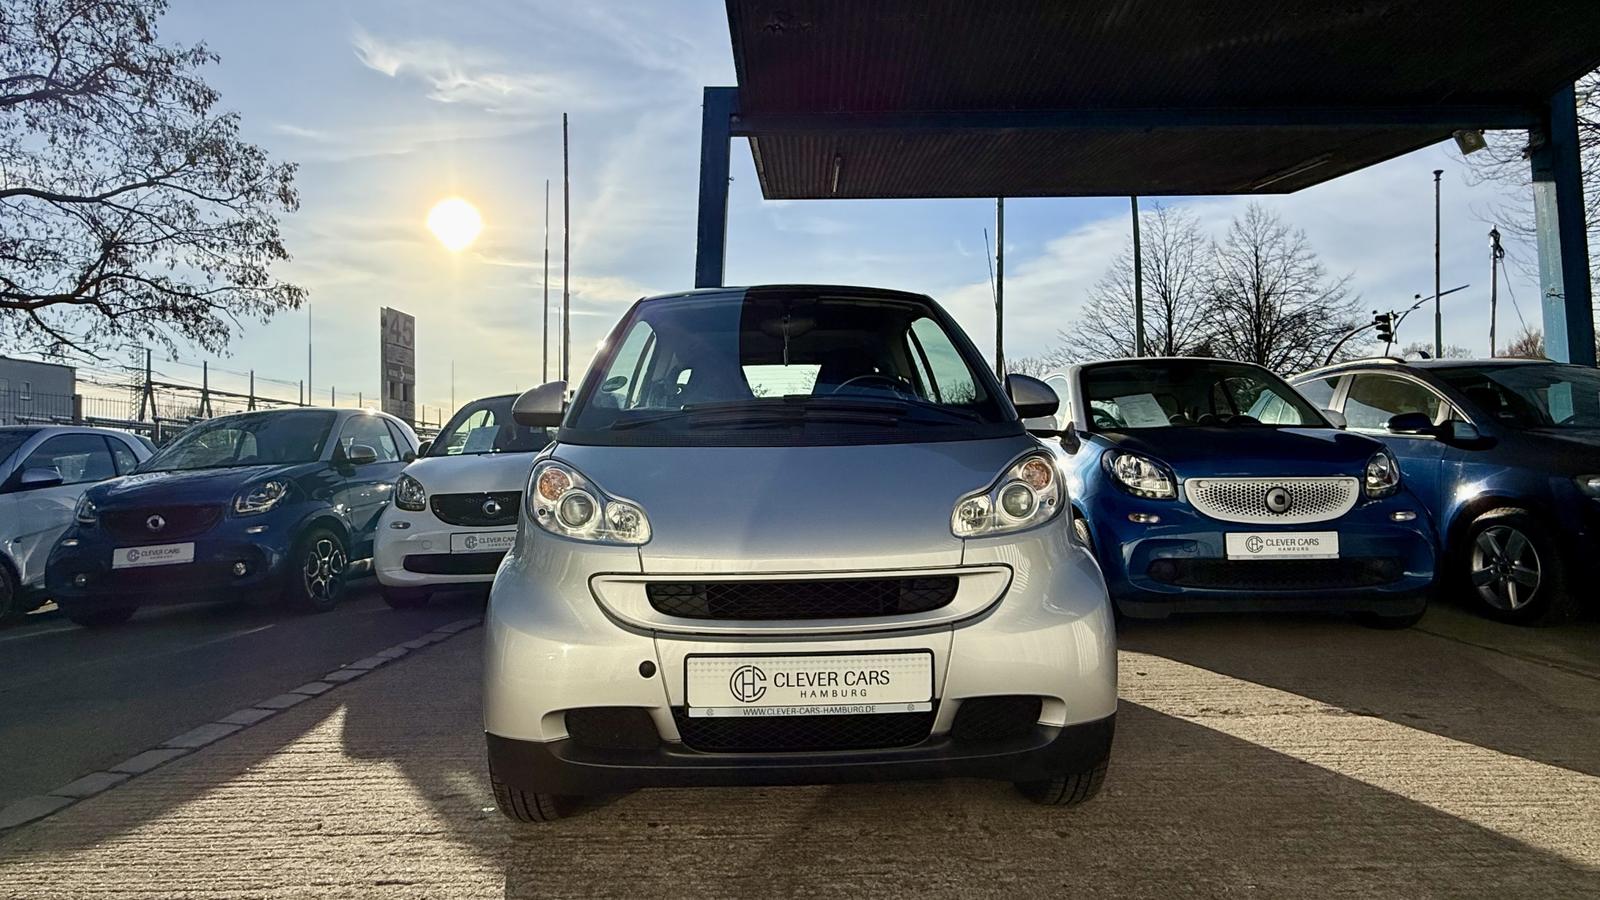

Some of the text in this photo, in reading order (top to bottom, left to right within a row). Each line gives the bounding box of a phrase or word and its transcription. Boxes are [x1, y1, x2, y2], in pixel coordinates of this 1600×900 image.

[391, 314, 412, 347] 45
[1266, 538, 1320, 547] CLEVER CARS
[774, 670, 890, 688] CLEVER CARS
[800, 689, 867, 699] HAMBURG
[743, 705, 876, 716] WWW.CLEVER-CARS-HAMBURG.DE
